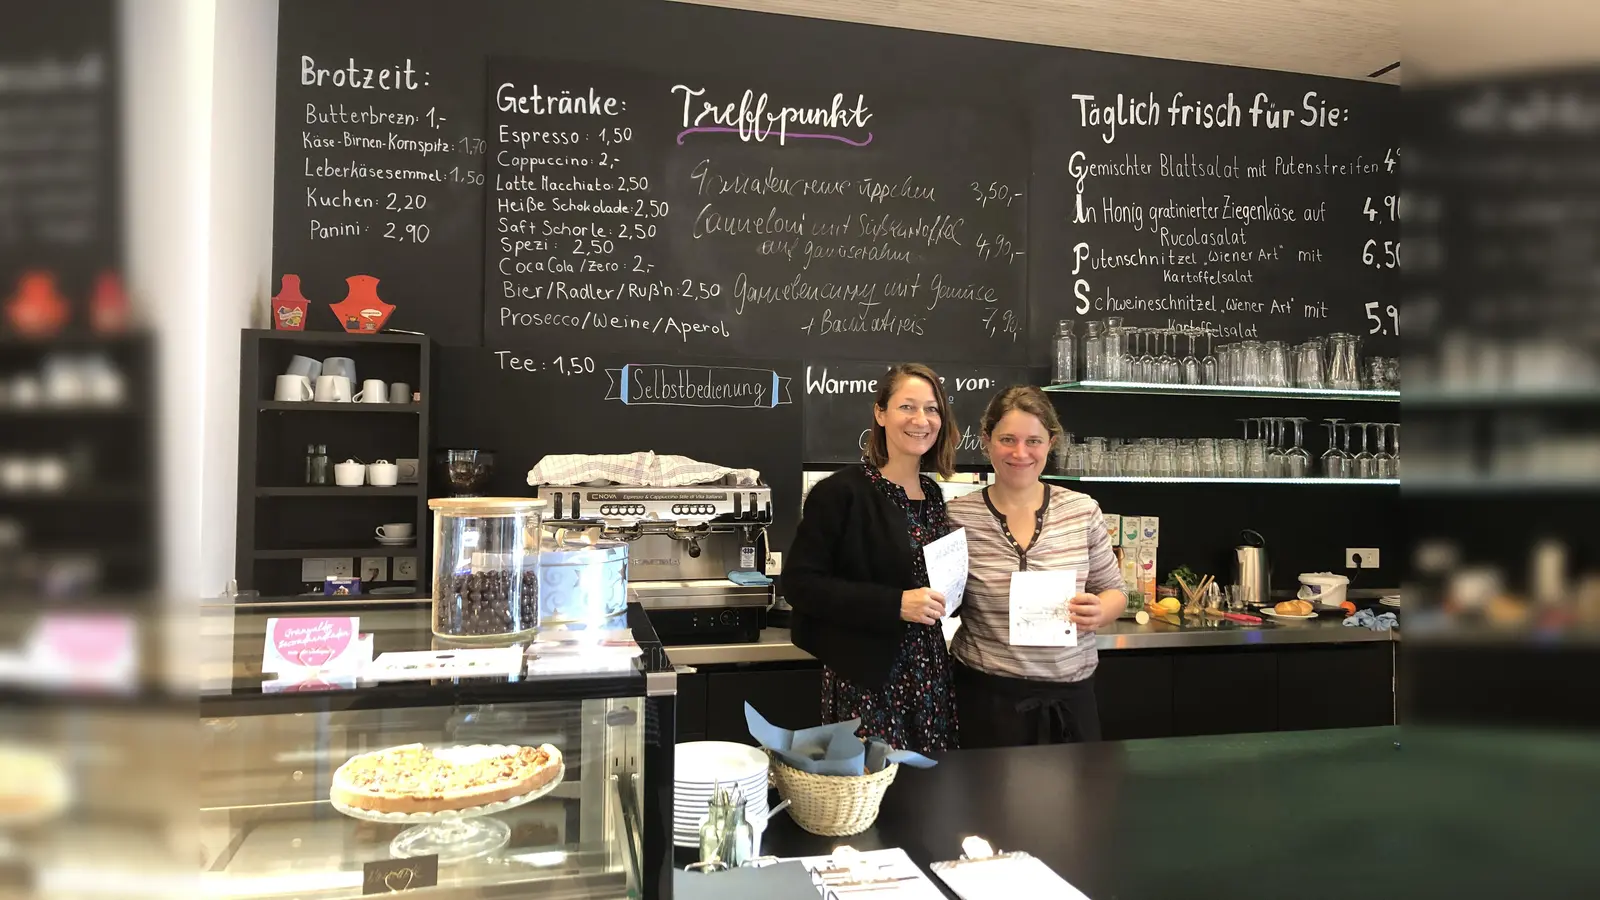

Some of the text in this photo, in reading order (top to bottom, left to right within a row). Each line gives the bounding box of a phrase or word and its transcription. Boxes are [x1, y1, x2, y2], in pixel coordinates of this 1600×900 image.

[301, 55, 430, 91] Brotzeit:
[496, 82, 626, 116] Getränke:
[306, 102, 447, 130] Butterbrezn: 1,-
[670, 84, 873, 146] Treffpunkt
[1071, 91, 1349, 144] Täglich frisch für Sie:
[302, 130, 487, 157] Käse-Birnen-Kornspitz: 1,70
[499, 124, 632, 150] Espresso: 1,50
[304, 157, 485, 186] Leberkäsesemmel: 1,50
[496, 149, 595, 173] Cappuccino:
[1068, 150, 1152, 195] Gemischter
[1159, 152, 1240, 179] Blattsalat
[1247, 162, 1267, 178] mit
[1275, 153, 1379, 176] Putenstreifen
[496, 173, 649, 193] Latte Macchiato: 2,50
[306, 186, 427, 213] Kuchen: 2,20
[497, 196, 669, 219] Heiße Schokolade: 2,50
[1072, 193, 1400, 235] In Honig gratinierter Ziegenkäse auf 4,9
[309, 217, 430, 244] Panini: 2,90
[497, 217, 657, 240] Saft Schorle: 2,50
[1160, 226, 1247, 247] Rucolasalat
[500, 236, 614, 257] Spezi: 2,50
[1071, 240, 1199, 277] Putenschnitzel
[1298, 249, 1323, 262] mit
[681, 278, 721, 301] 2,50
[1163, 269, 1253, 285] Kartoffelsalat
[1073, 277, 1218, 315] Schweineschnitzel
[1304, 301, 1329, 319] mit
[1364, 301, 1400, 337] 5.9
[500, 306, 730, 343] Prosecco/Weine/Aperol
[494, 350, 595, 377] Tee: 1,50
[632, 368, 767, 407] Selbstbedienung
[806, 365, 878, 395] Warme
[955, 376, 996, 392] von:
